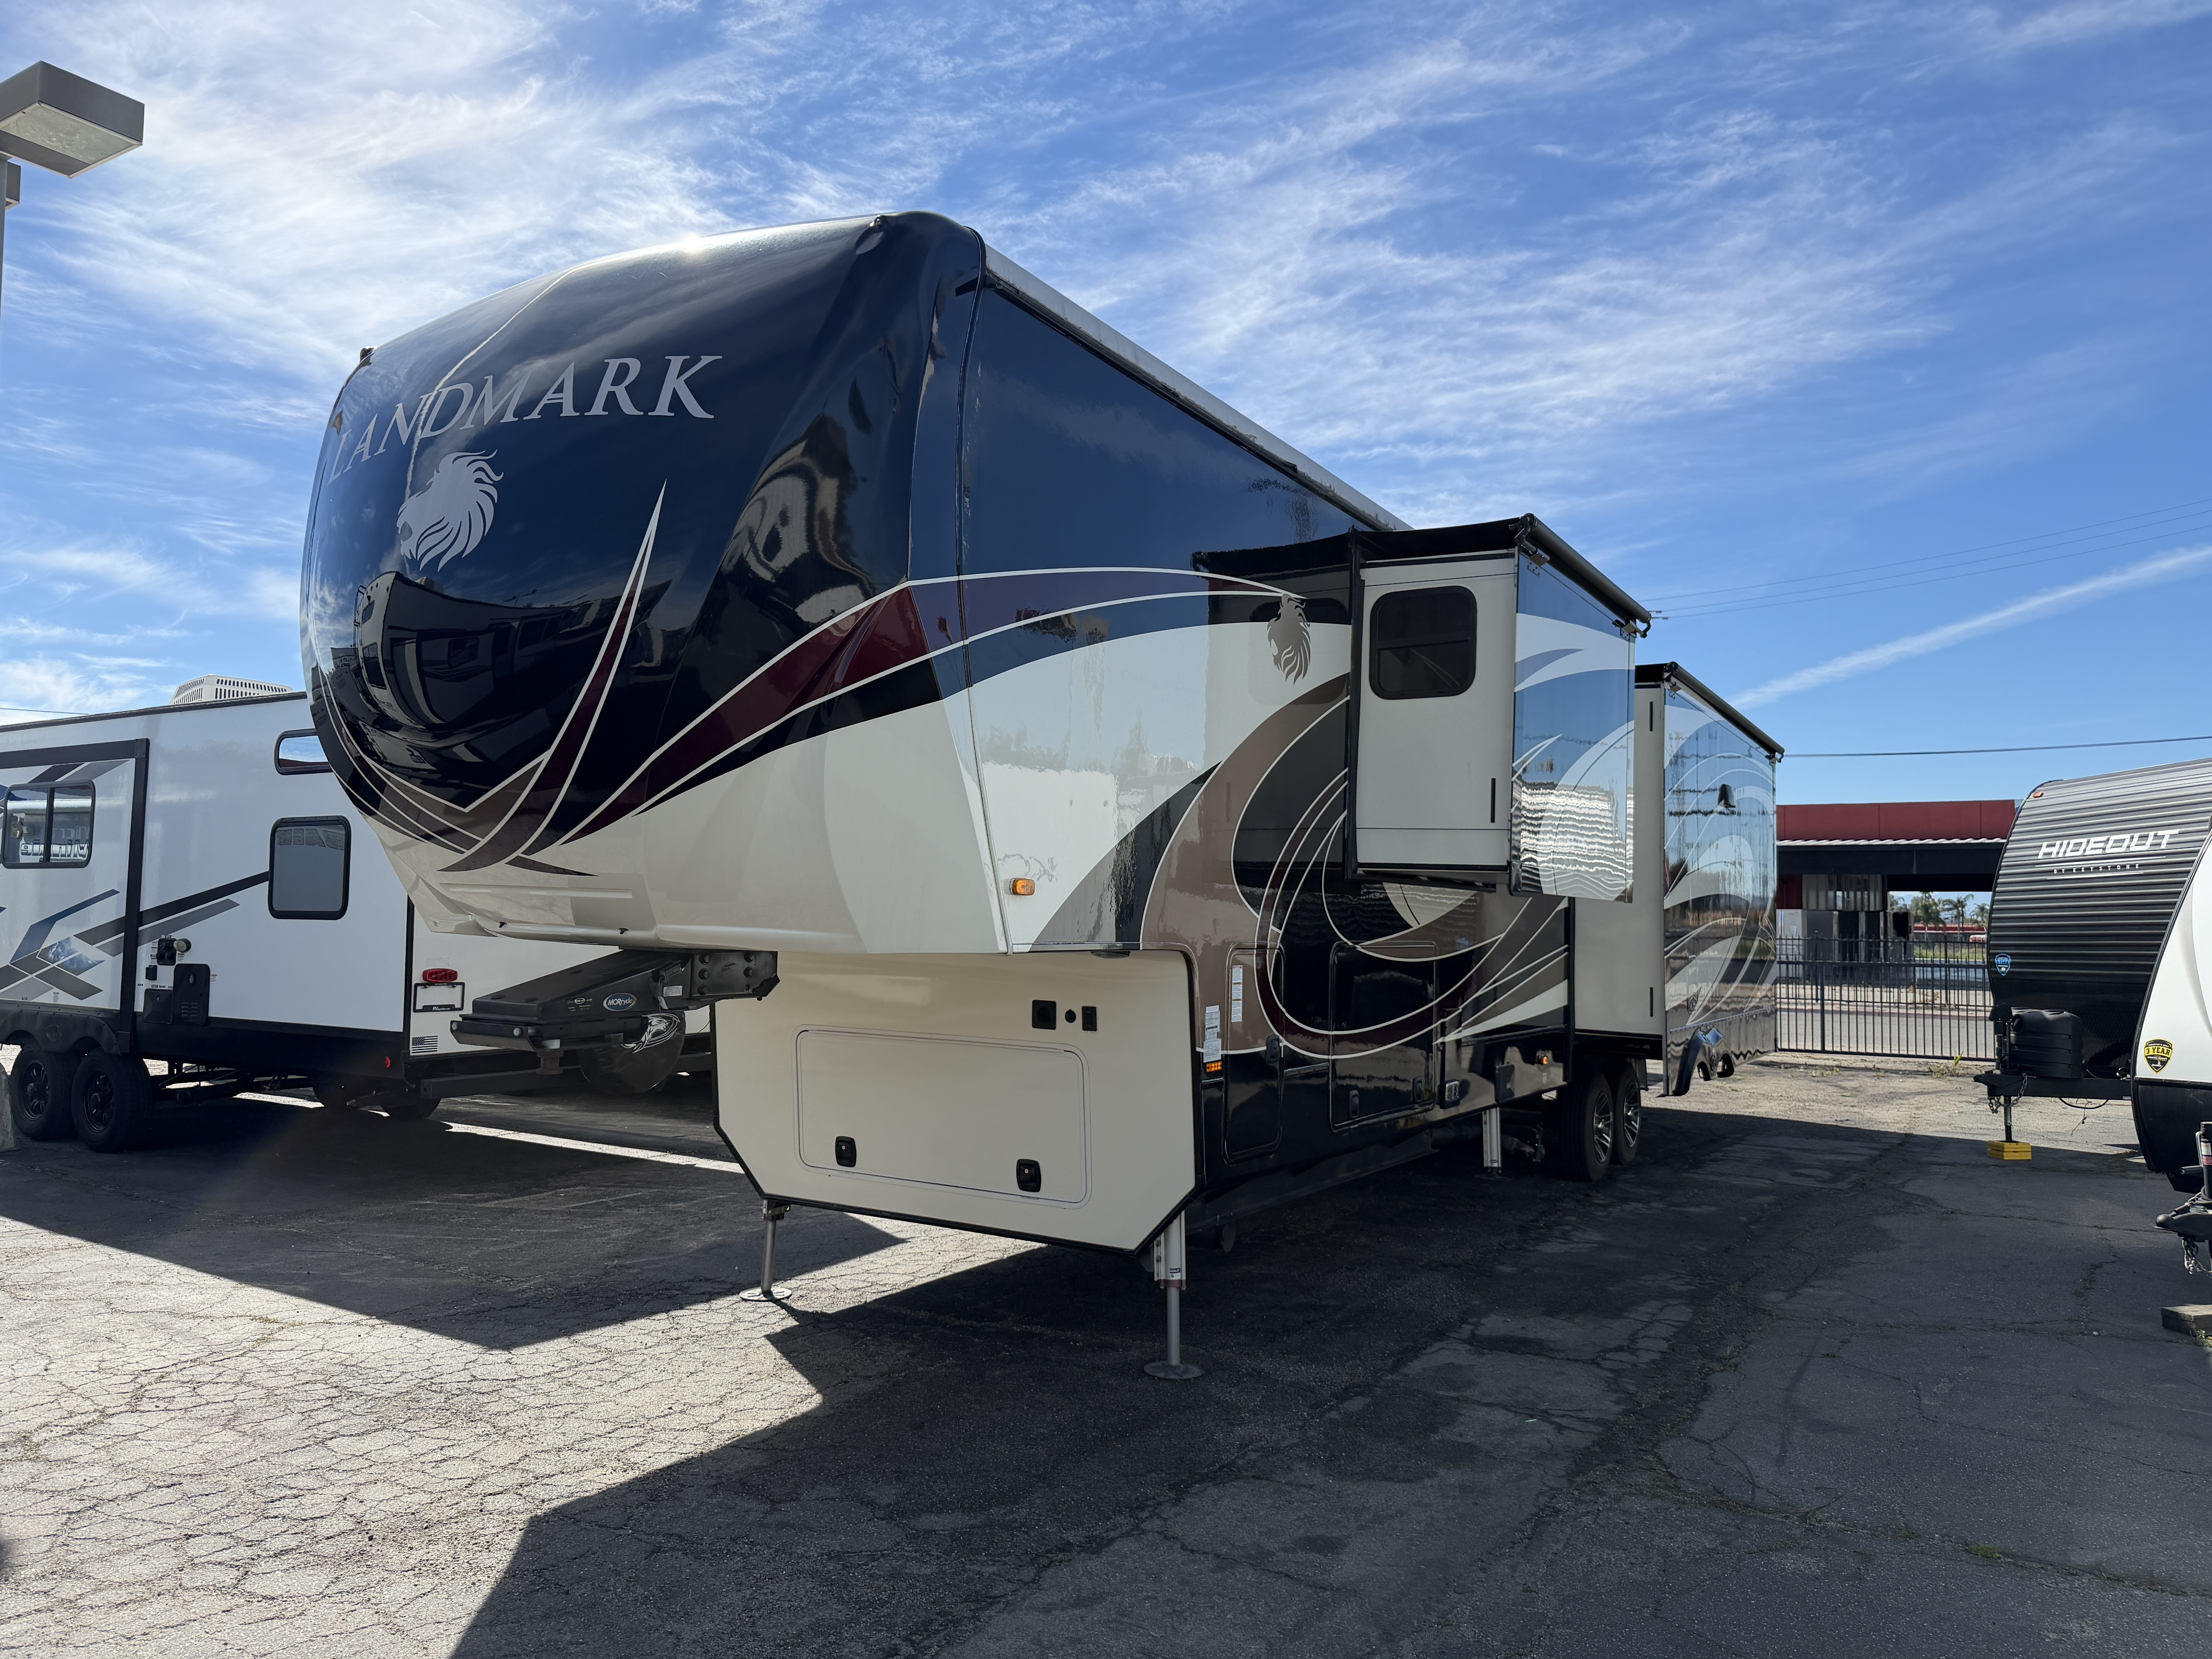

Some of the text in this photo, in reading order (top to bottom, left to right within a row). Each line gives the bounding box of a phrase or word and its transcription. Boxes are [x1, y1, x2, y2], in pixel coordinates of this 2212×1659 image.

[326, 355, 722, 486] LANDMARK
[2037, 829, 2180, 859] HIDEOUT
[2073, 864, 2139, 872] KEYSTONE
[608, 998, 632, 1006] MORryde
[2152, 1047, 2170, 1055] YEAR
